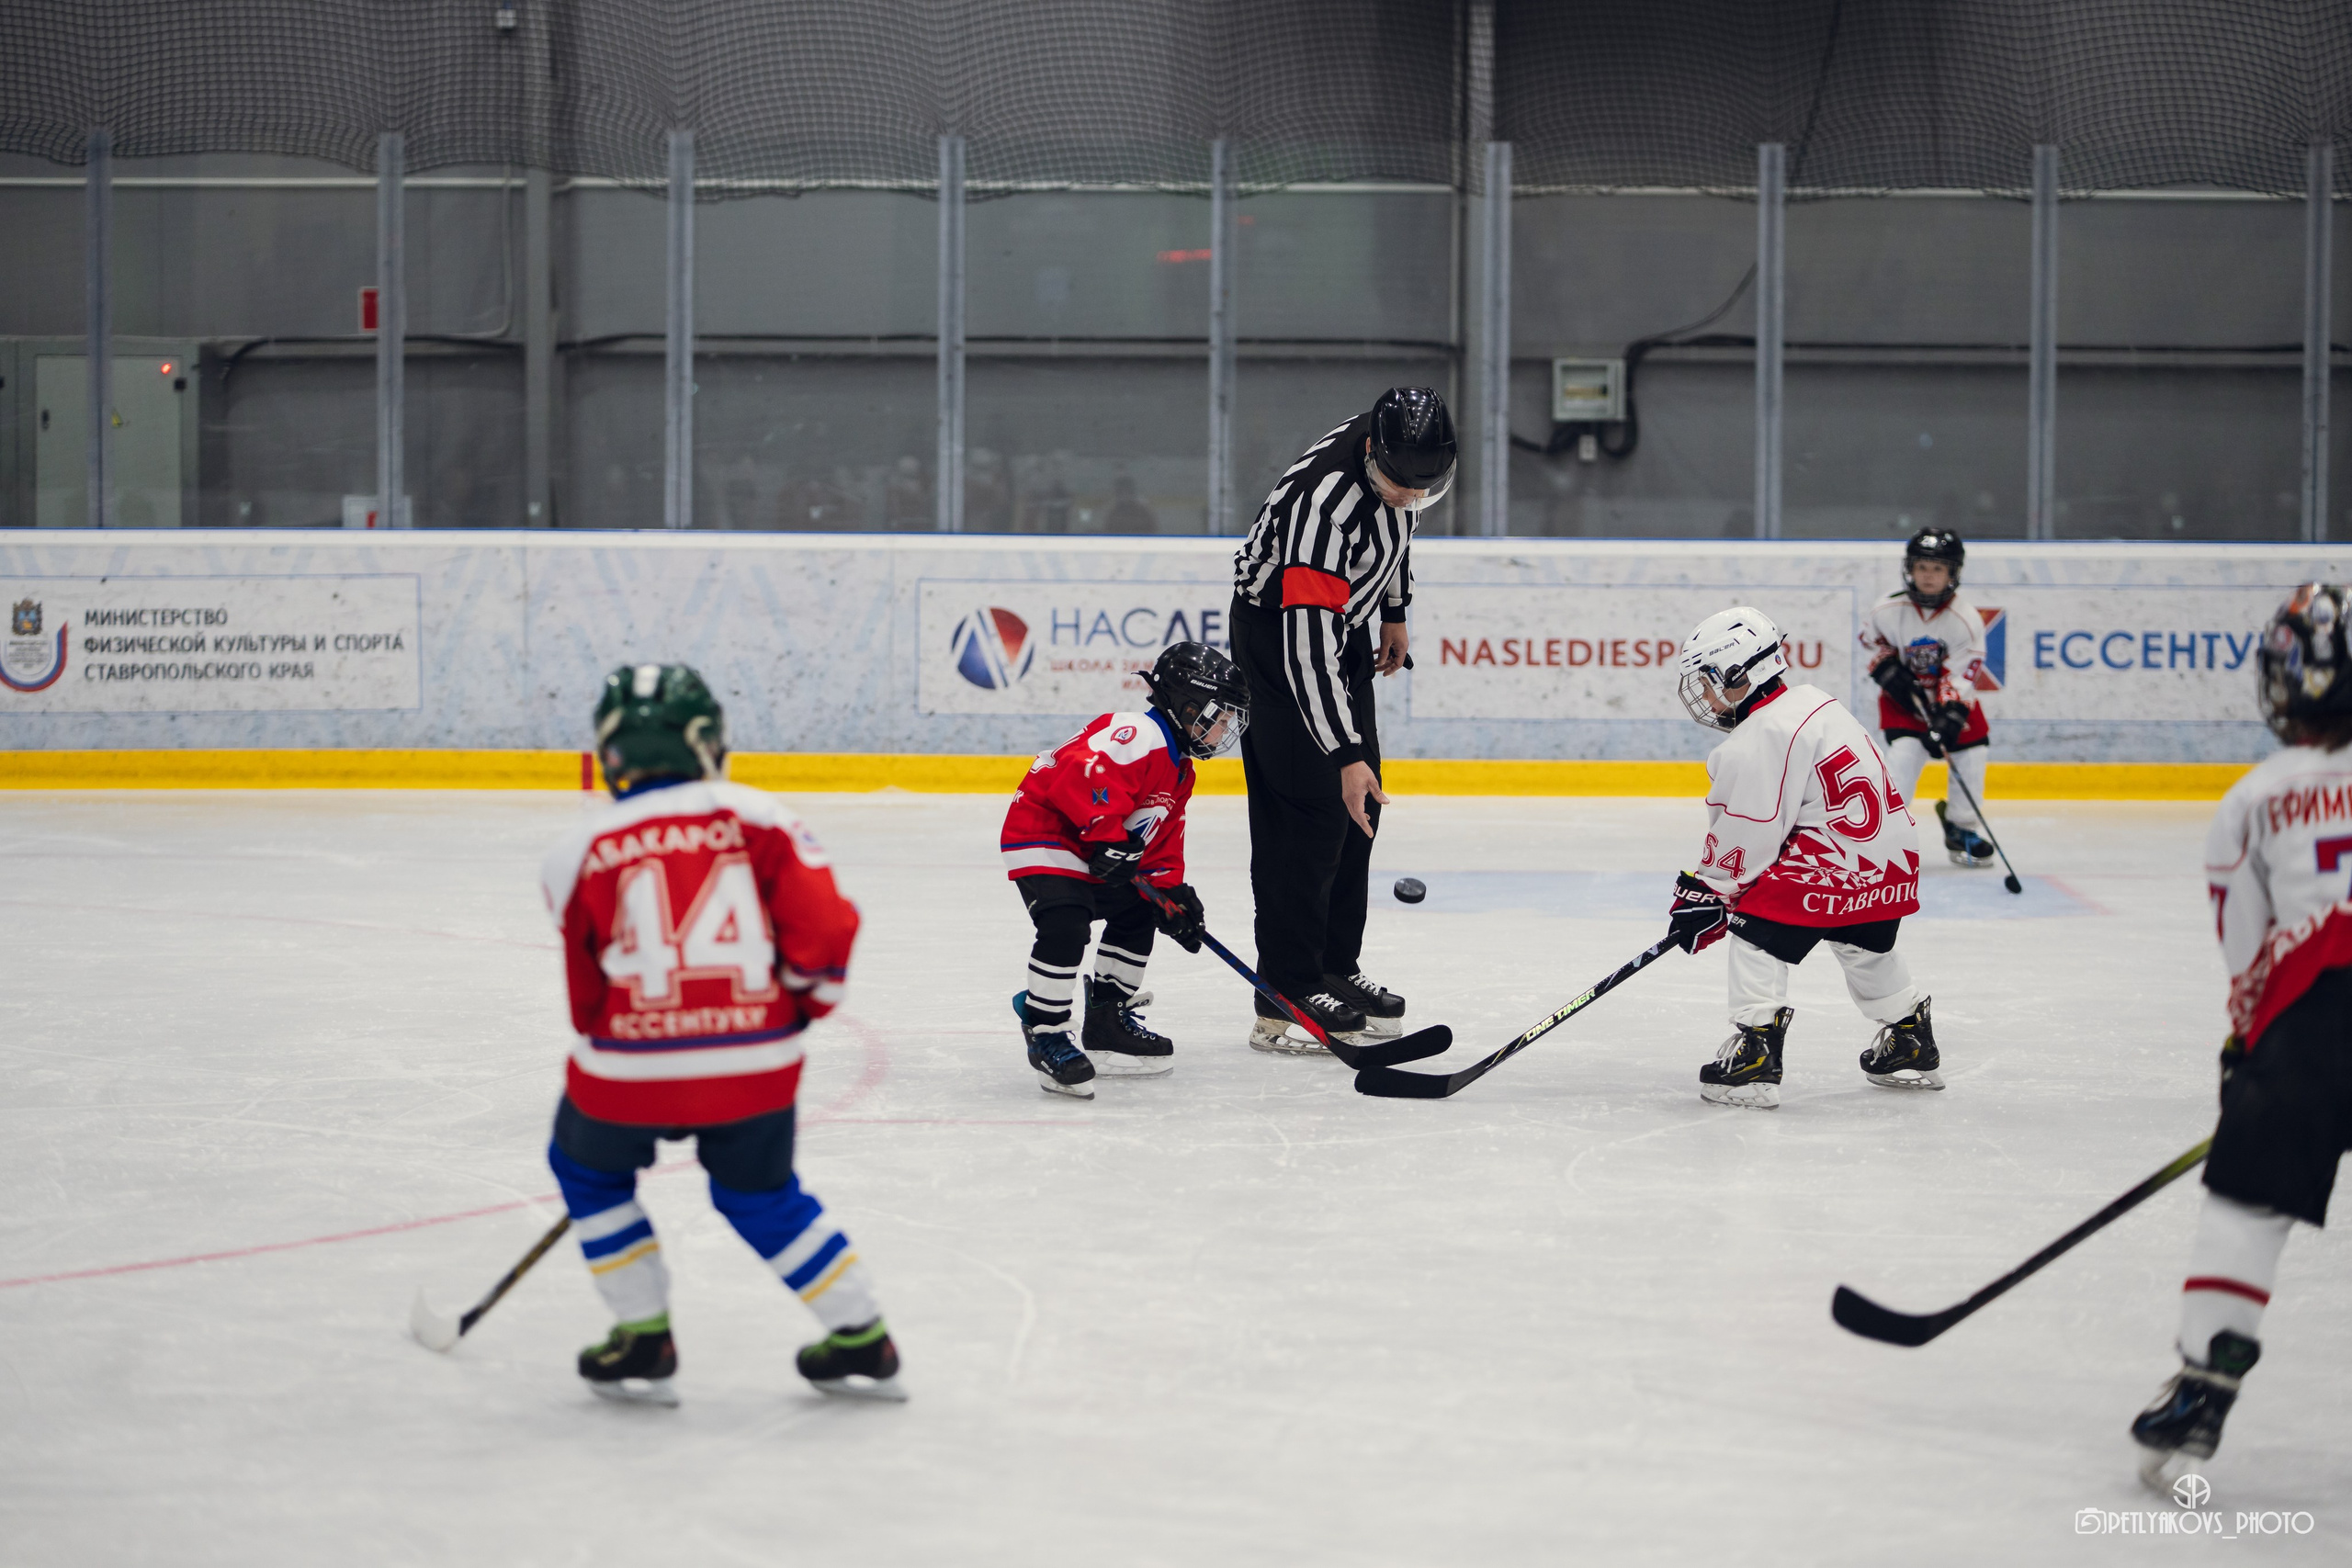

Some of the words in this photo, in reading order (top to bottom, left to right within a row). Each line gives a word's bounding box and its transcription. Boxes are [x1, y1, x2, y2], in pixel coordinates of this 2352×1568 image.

[85, 608, 228, 626] МИНИСТЕРСТВО
[1051, 607, 1230, 648] НАСЛЕ
[84, 630, 206, 653] ФИЗИЧЕСКОЙ
[214, 635, 306, 652] КУЛЬТУРЫ
[314, 634, 326, 650] И
[334, 634, 404, 652] СПОРТА
[2033, 629, 2265, 671] ЕССЕНТУ
[84, 661, 262, 681] СТАВРОПОЛЬСКОГО
[269, 661, 314, 679] КРАЯ
[1190, 679, 1218, 691] BAUER
[1701, 831, 1747, 880] 54
[599, 851, 780, 1010] 44
[1525, 1015, 1555, 1042] ONE
[1555, 987, 1596, 1021] TIMER
